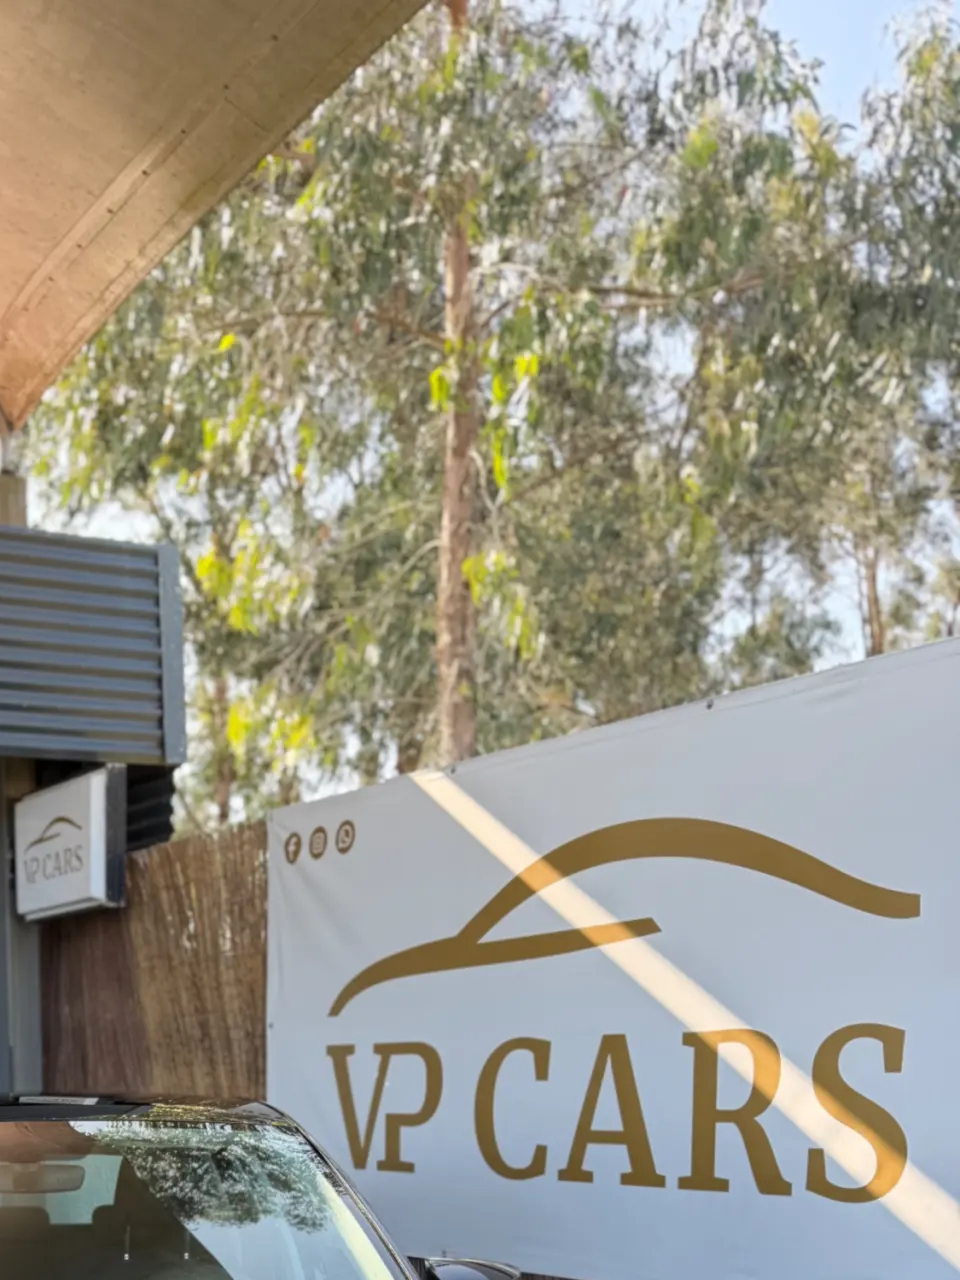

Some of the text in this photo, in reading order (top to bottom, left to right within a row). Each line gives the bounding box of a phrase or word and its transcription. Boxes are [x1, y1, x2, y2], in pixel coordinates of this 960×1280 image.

[42, 844, 84, 880] CARS
[325, 1022, 908, 1204] VP CARS
